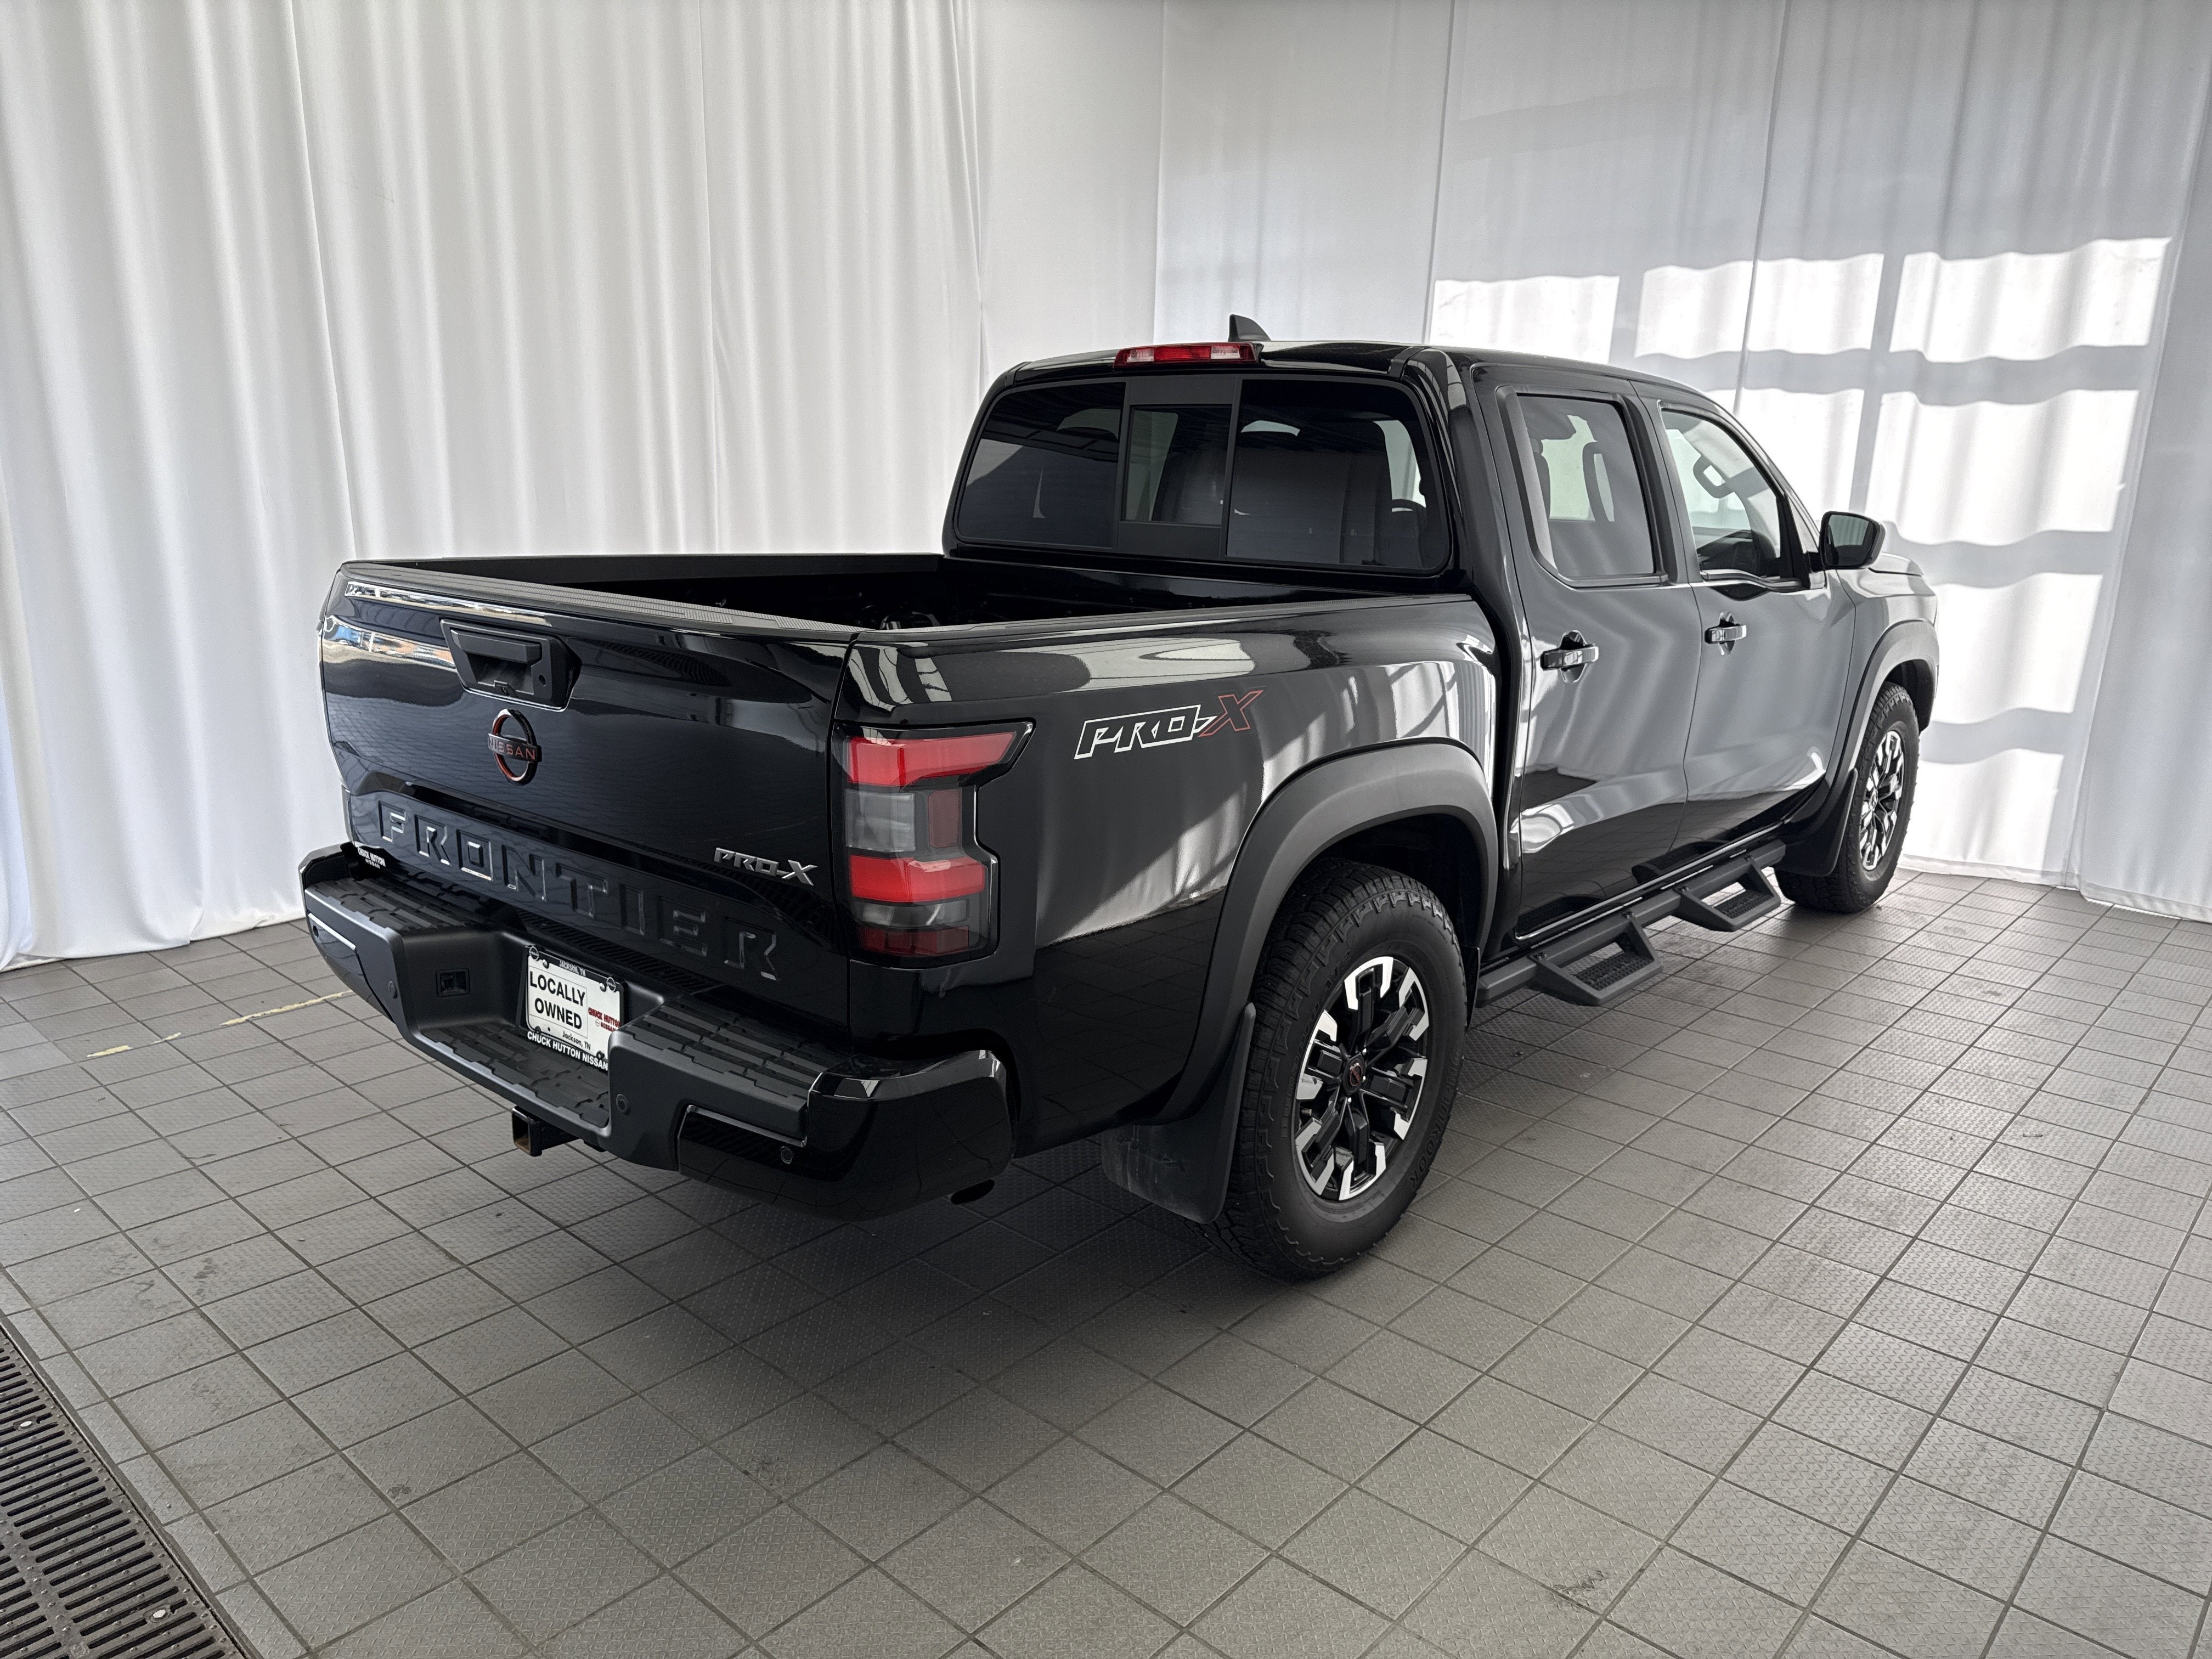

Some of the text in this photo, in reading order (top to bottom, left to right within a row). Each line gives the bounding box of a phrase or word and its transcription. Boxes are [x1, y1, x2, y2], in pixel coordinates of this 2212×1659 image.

[488, 735, 536, 760] NISSAN
[714, 847, 819, 887] PRO-X
[378, 800, 781, 981] FRONTIER
[529, 970, 585, 1006] LOCALLY
[534, 997, 582, 1029] OWNED
[527, 1030, 608, 1071] CHUCK HUTTON NISSAN
[562, 1030, 591, 1051] Jackson, TN
